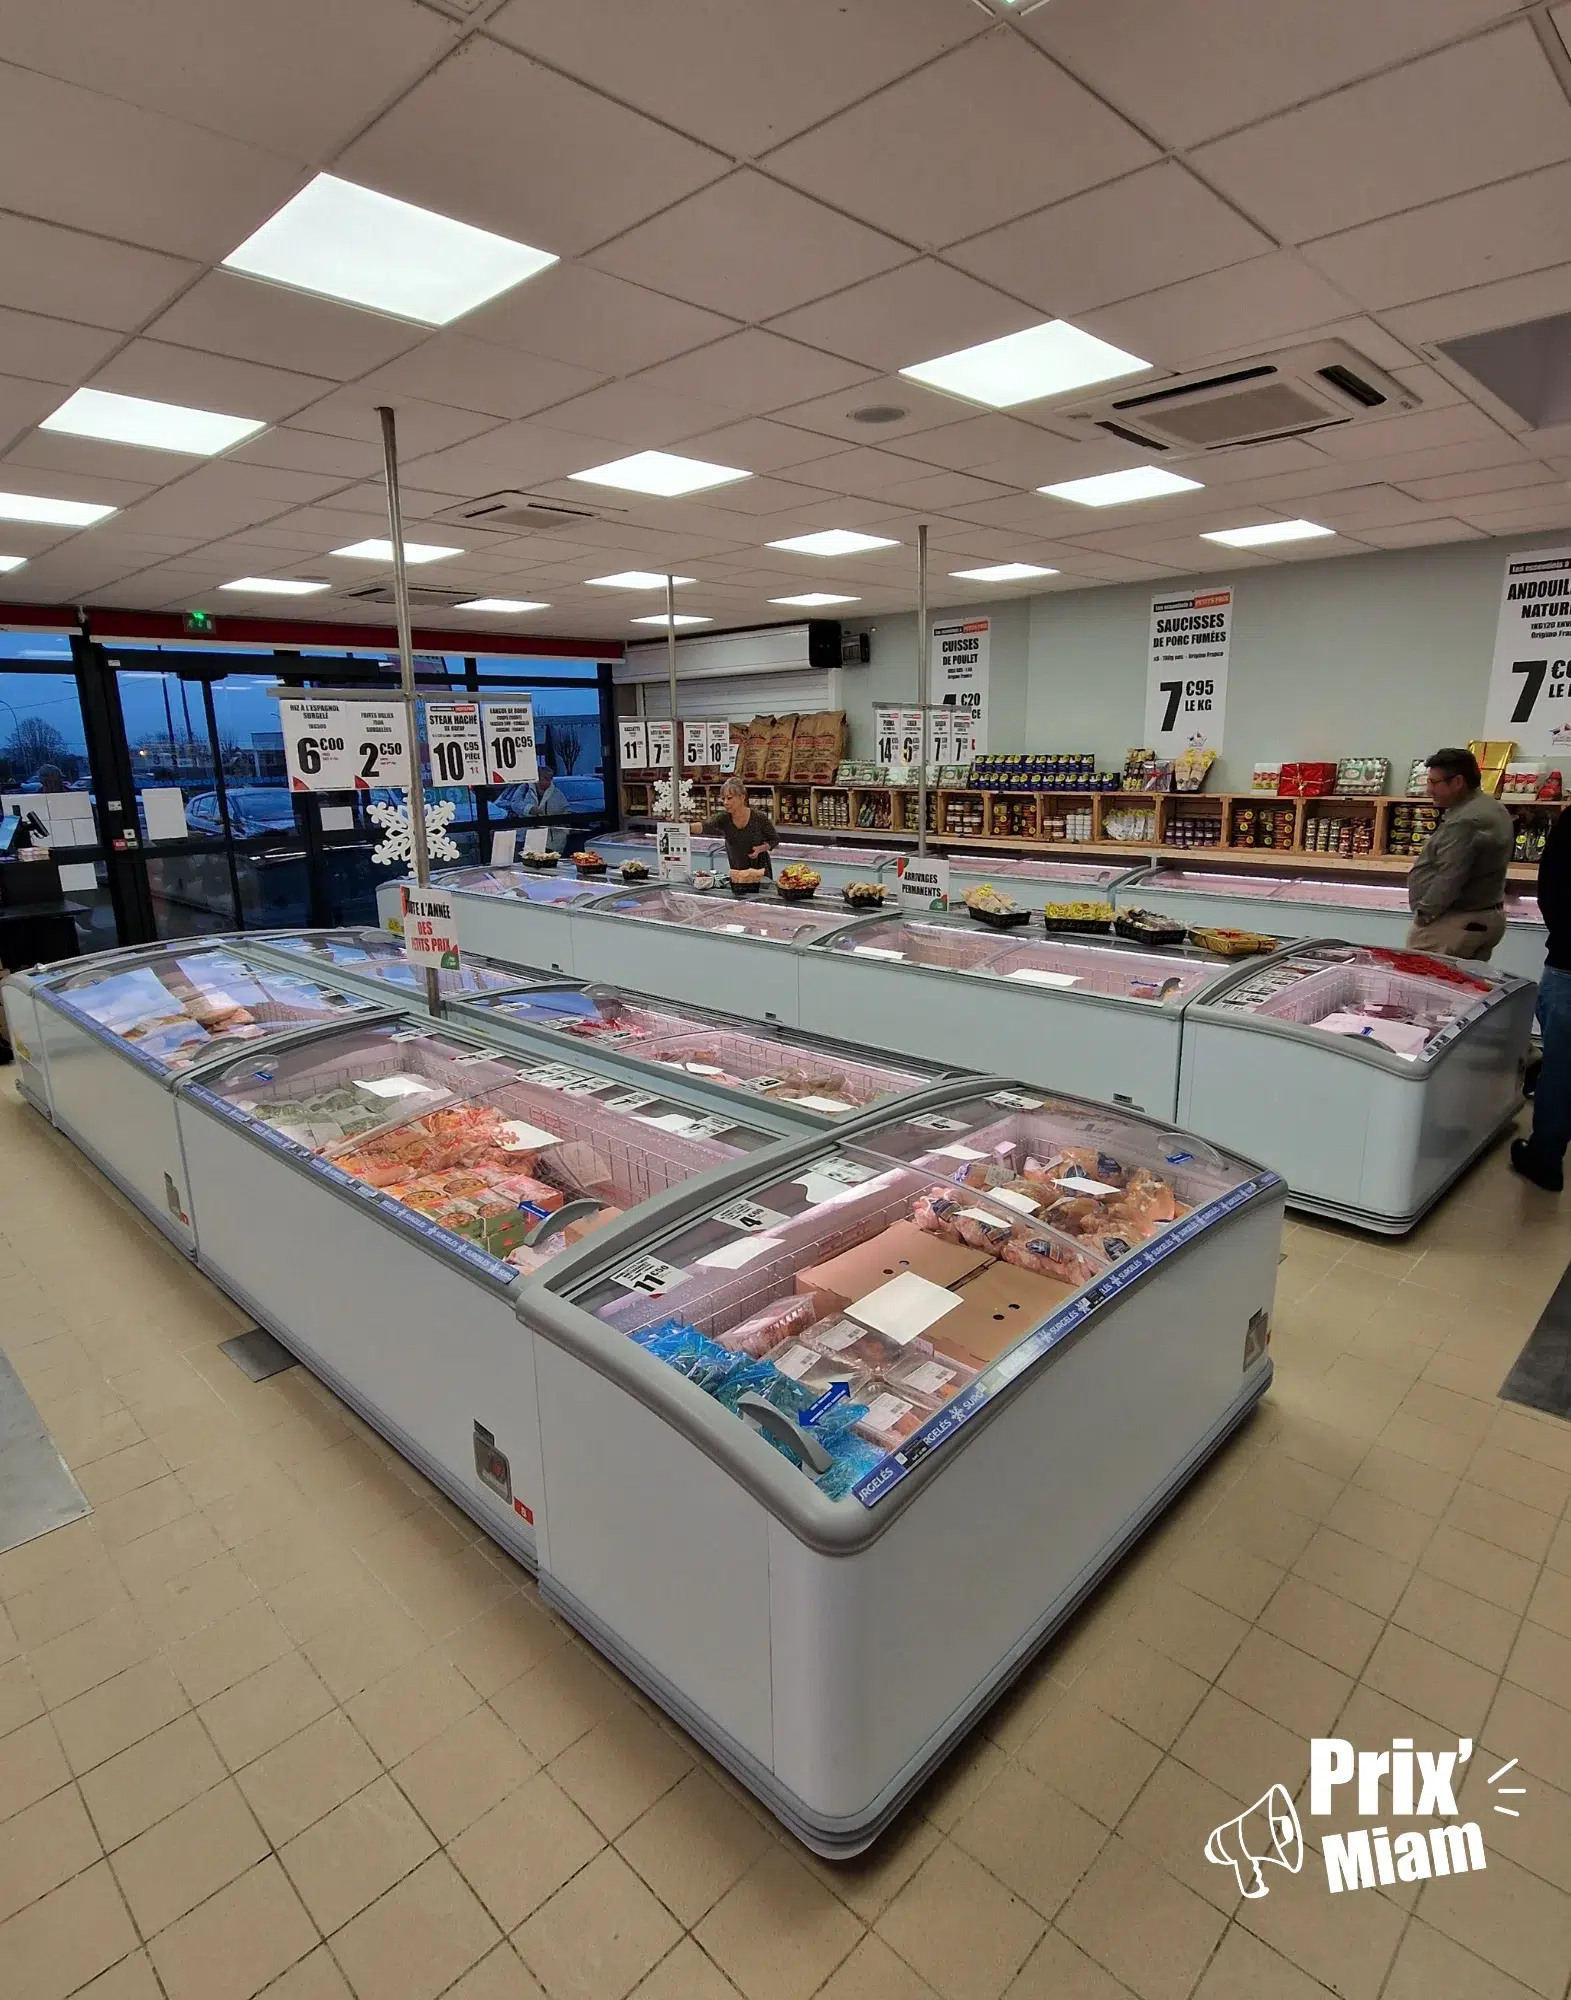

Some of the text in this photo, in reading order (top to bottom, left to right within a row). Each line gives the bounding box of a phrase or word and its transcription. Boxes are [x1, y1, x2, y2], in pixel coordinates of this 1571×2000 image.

[1507, 578, 1571, 600] ANDOUIL
[1521, 602, 1571, 618] NATUR
[1157, 613, 1224, 633] SAUCISSES
[942, 638, 979, 652] CUISSES
[1153, 630, 1226, 648] DE PORC FUMÉES
[943, 654, 979, 666] DE POULET
[1510, 660, 1547, 723] 7
[1549, 684, 1565, 698] LE
[1160, 680, 1214, 732] 7 €95
[1185, 699, 1212, 711] LE KG
[429, 715, 453, 725] STEAK
[297, 737, 321, 775] 6
[491, 736, 516, 769] 10
[624, 741, 637, 759] 11
[654, 744, 662, 764] 7
[688, 743, 697, 763] 5
[710, 743, 721, 762] 18
[879, 737, 892, 763] 14
[935, 738, 941, 761] 7
[956, 738, 961, 761] 7
[360, 742, 379, 777] 2
[433, 741, 464, 781] 10
[904, 871, 938, 884] ARRIVAGES
[902, 884, 941, 897] PERMANENTS
[421, 902, 451, 919] L'ANNÉE
[417, 921, 433, 936] DES
[465, 1249, 491, 1267] SURGELÉS
[633, 1274, 666, 1292] 11
[1049, 1309, 1079, 1335] SURGELÉS
